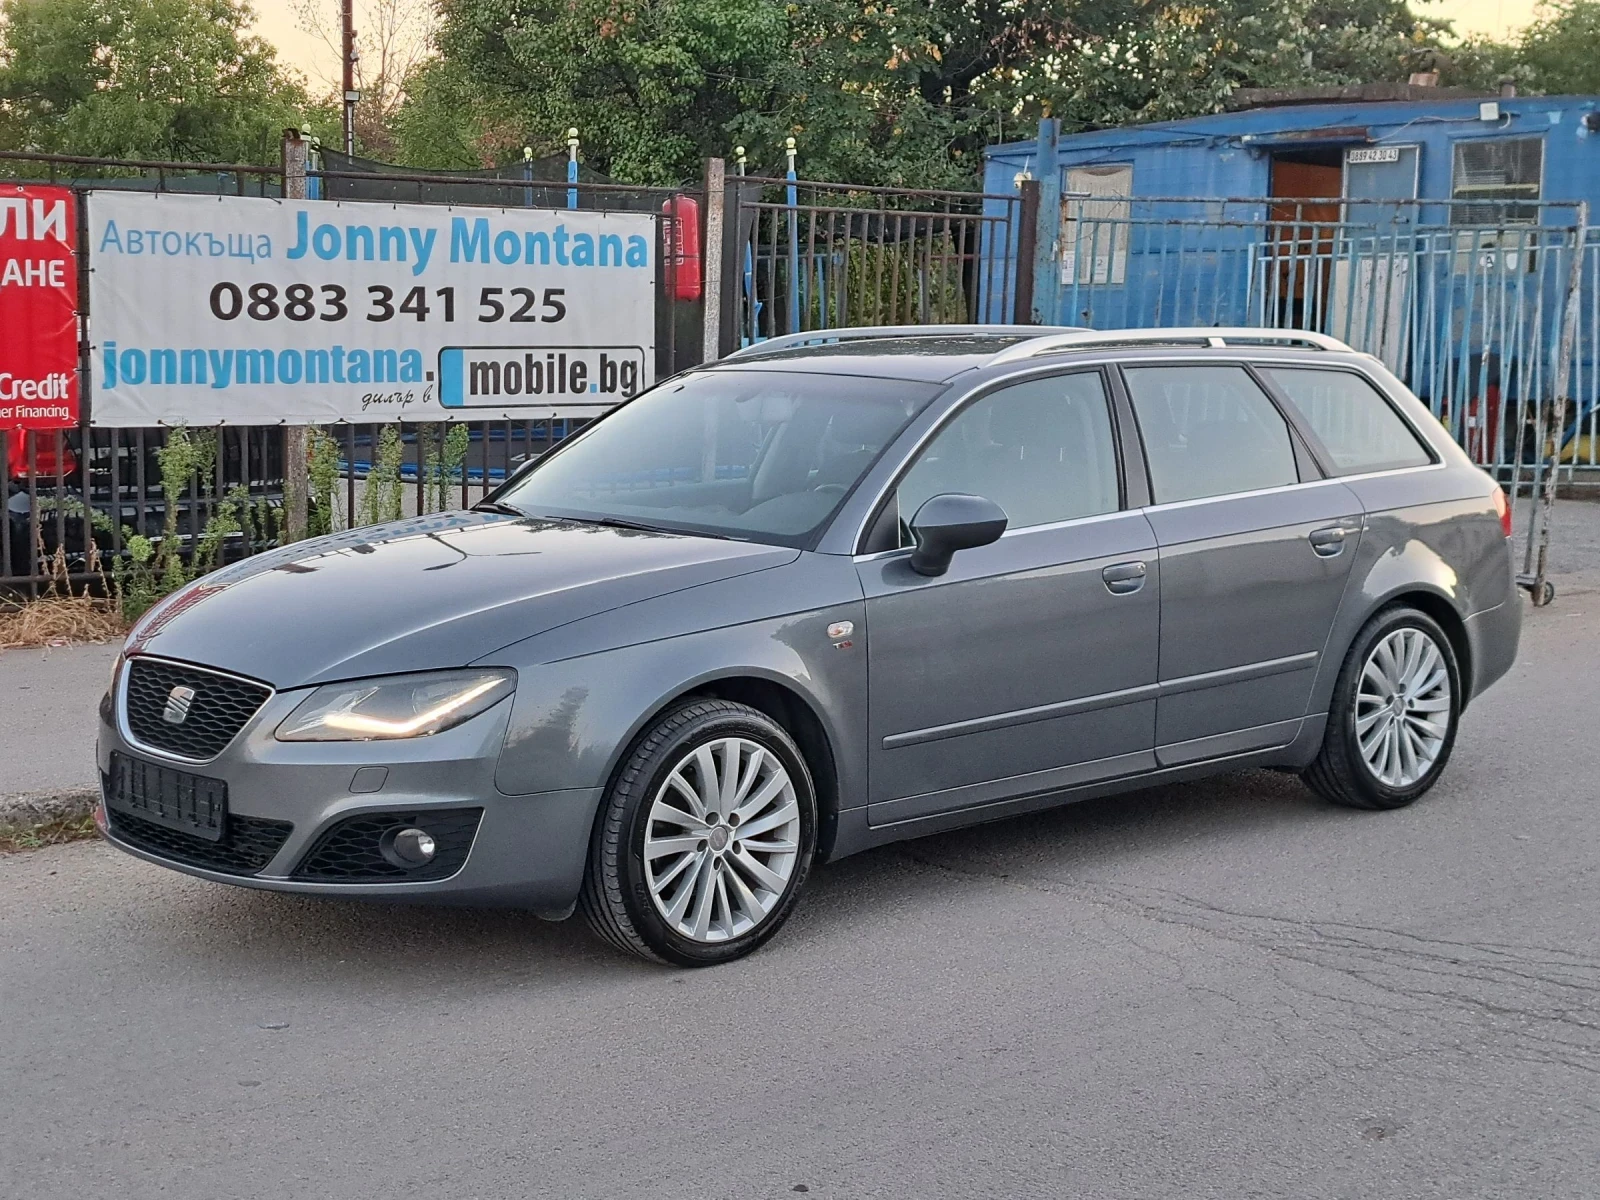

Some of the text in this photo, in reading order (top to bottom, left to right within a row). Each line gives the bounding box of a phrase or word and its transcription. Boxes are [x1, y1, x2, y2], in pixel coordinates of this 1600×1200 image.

[100, 219, 272, 265] Автокъща
[286, 210, 437, 277] Jonny
[450, 216, 648, 268] Montana
[1, 258, 65, 288] АНЕ
[209, 281, 567, 323] 0883 341 525
[0, 372, 69, 400] Credit
[469, 353, 638, 397] mobile.bg
[0, 404, 69, 420] er Financing
